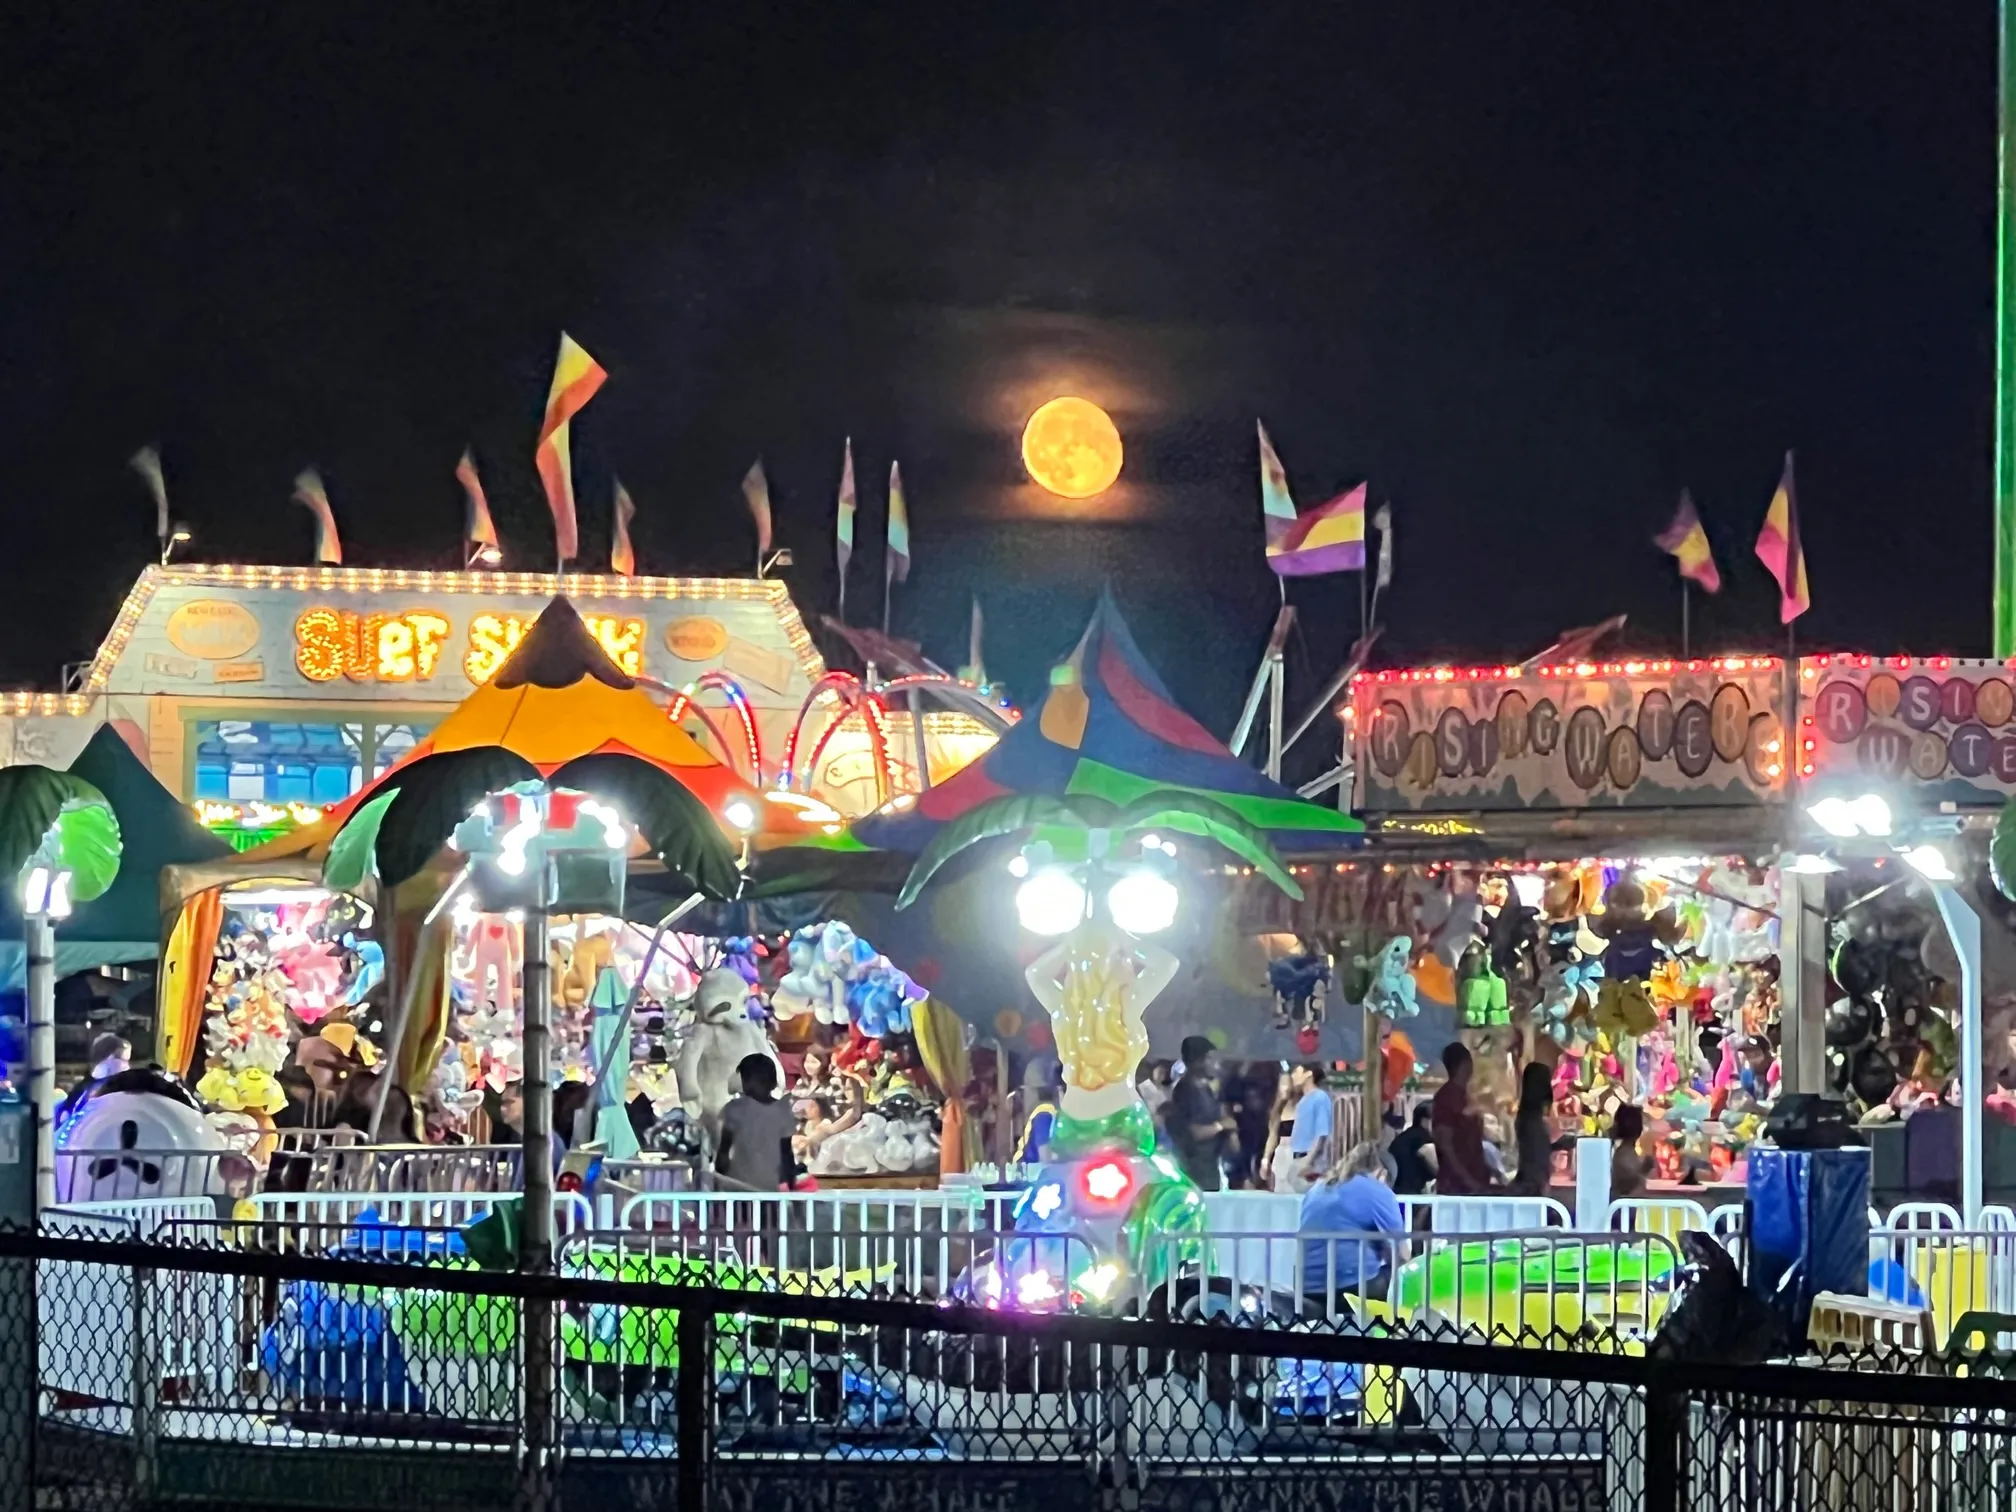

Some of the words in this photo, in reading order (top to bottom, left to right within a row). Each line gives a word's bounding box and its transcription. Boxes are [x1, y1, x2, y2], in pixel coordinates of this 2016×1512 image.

[296, 605, 451, 682] SURF
[1830, 686, 2008, 731] RISIN
[1382, 708, 1560, 783] RISING
[1868, 734, 2016, 776] WATE
[1457, 1477, 1604, 1512] WHALE
